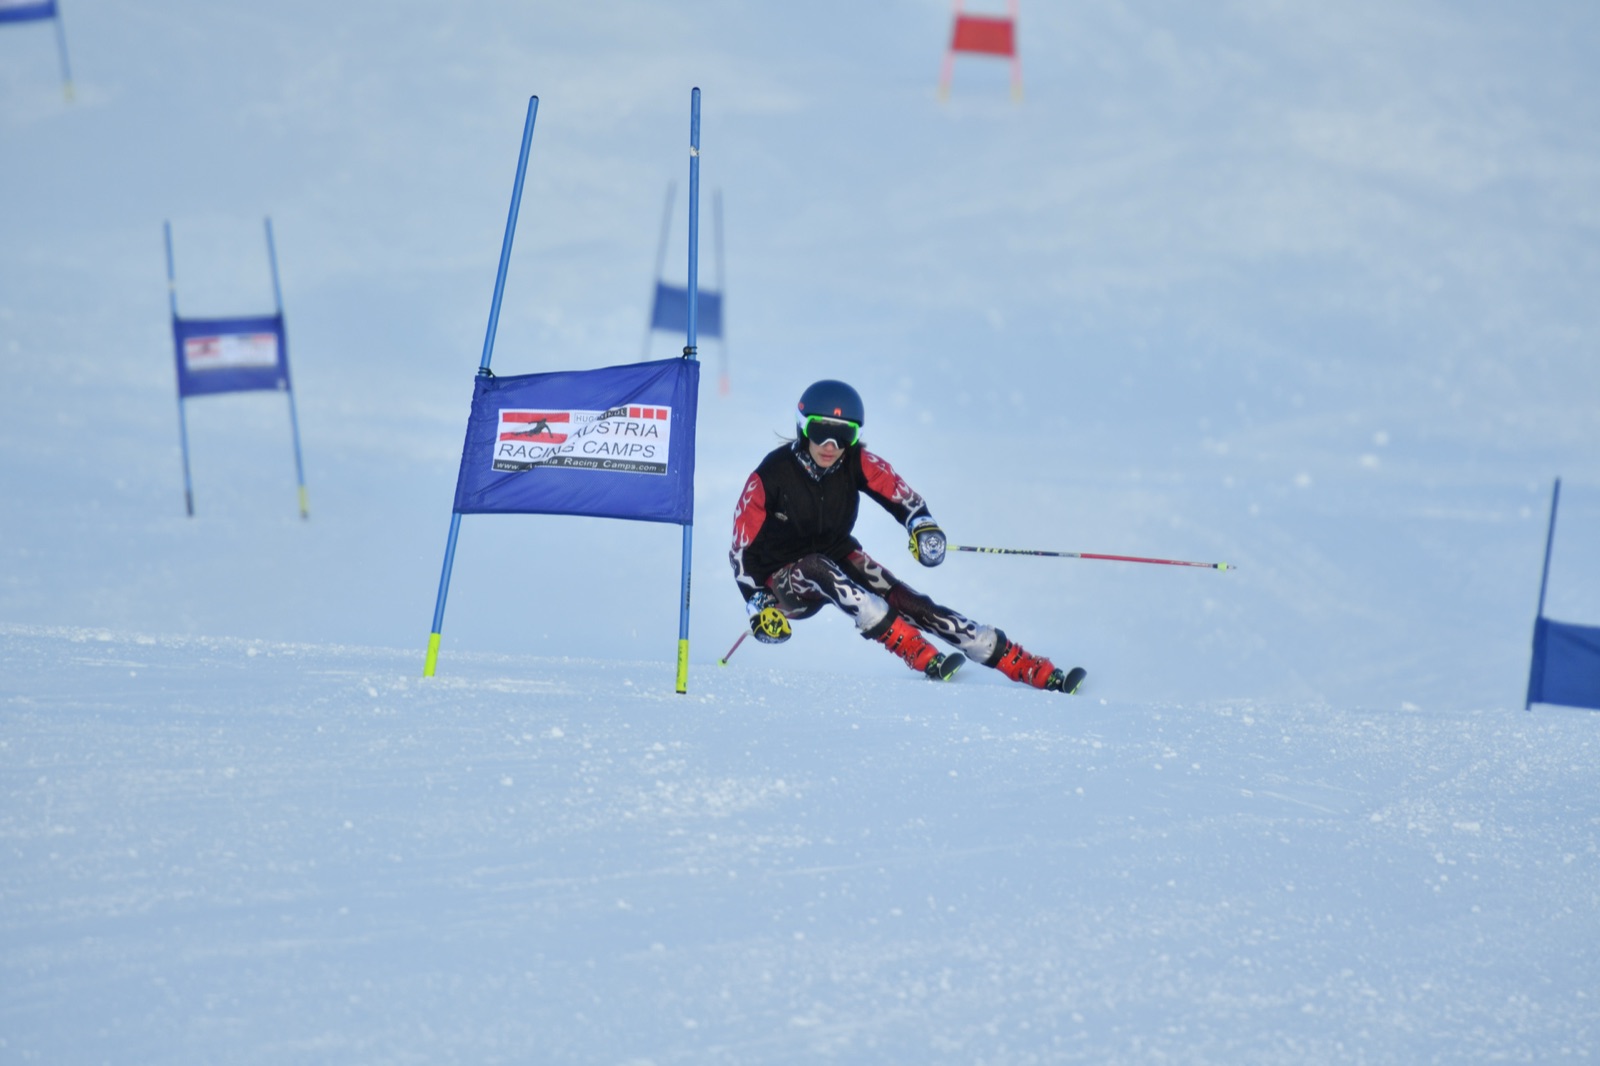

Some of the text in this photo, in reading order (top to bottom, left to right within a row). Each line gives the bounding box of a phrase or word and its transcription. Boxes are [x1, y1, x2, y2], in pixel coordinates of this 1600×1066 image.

[498, 440, 656, 460] RACING CAMPS
[563, 457, 599, 468] Racing
[602, 459, 657, 472] Camps.com
